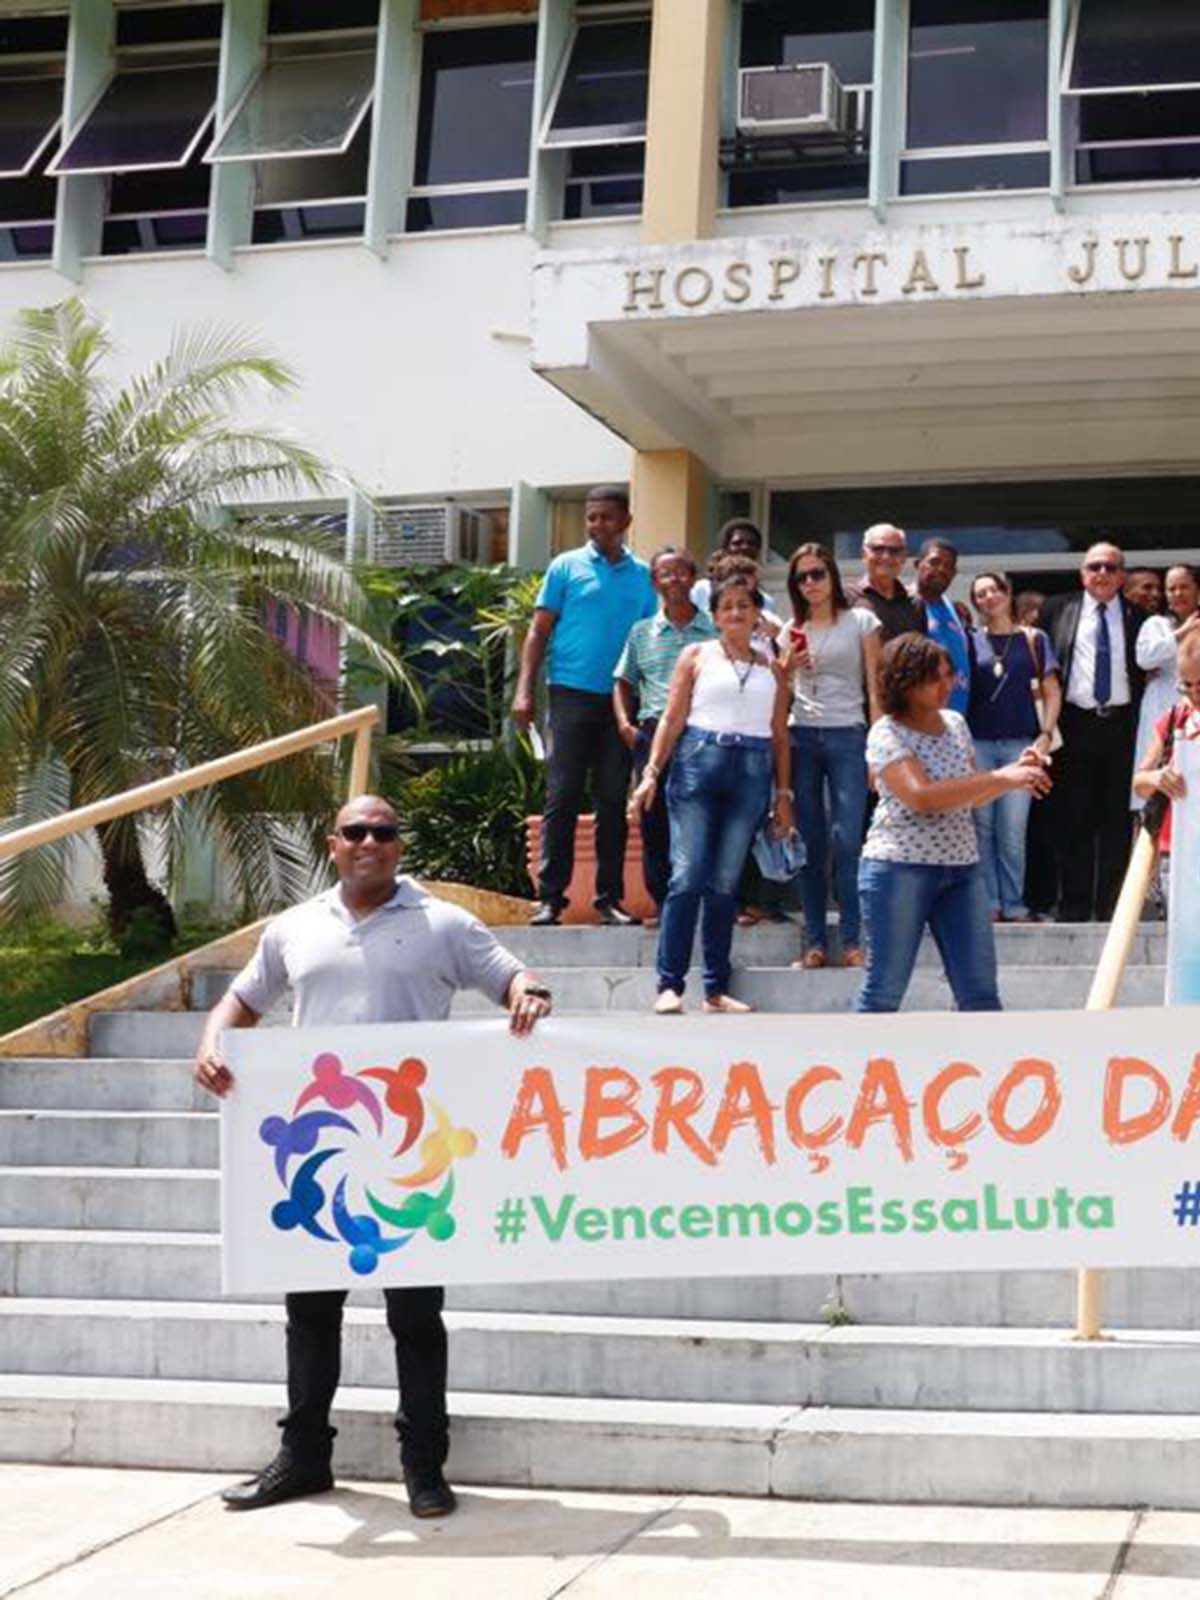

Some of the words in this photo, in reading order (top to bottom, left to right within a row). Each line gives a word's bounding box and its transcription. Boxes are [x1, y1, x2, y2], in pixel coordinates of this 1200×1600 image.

[623, 247, 986, 311] HOSPITAL
[500, 1057, 1063, 1173] ABRAÇAÇO
[495, 1184, 1114, 1243] #VencemosEssaLuta
